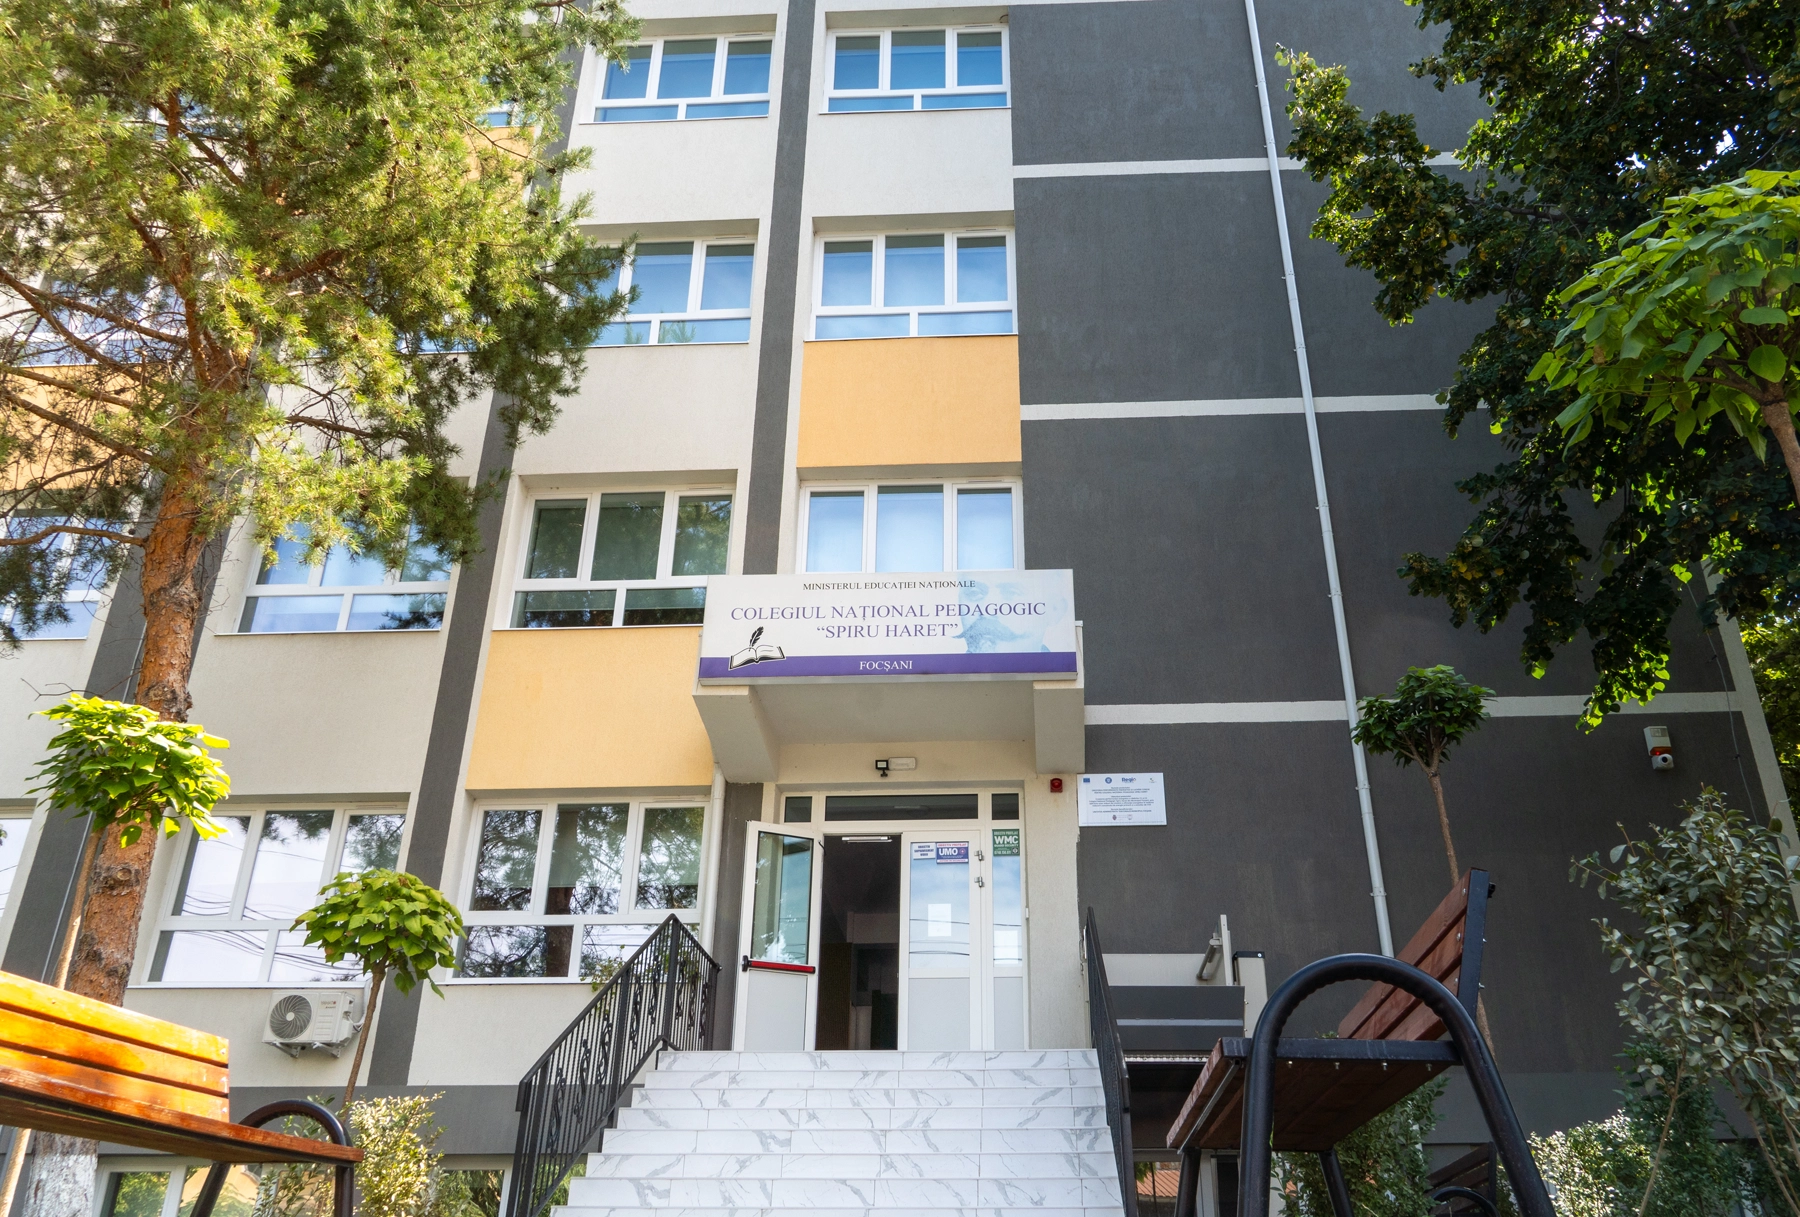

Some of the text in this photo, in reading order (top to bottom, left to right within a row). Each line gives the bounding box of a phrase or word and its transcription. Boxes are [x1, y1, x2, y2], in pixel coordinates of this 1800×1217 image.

[803, 582, 862, 591] MINISTERUL
[731, 606, 825, 620] COLEGIUL
[934, 602, 1046, 617] PEDAGOGIC
[994, 835, 1018, 844] WMC
